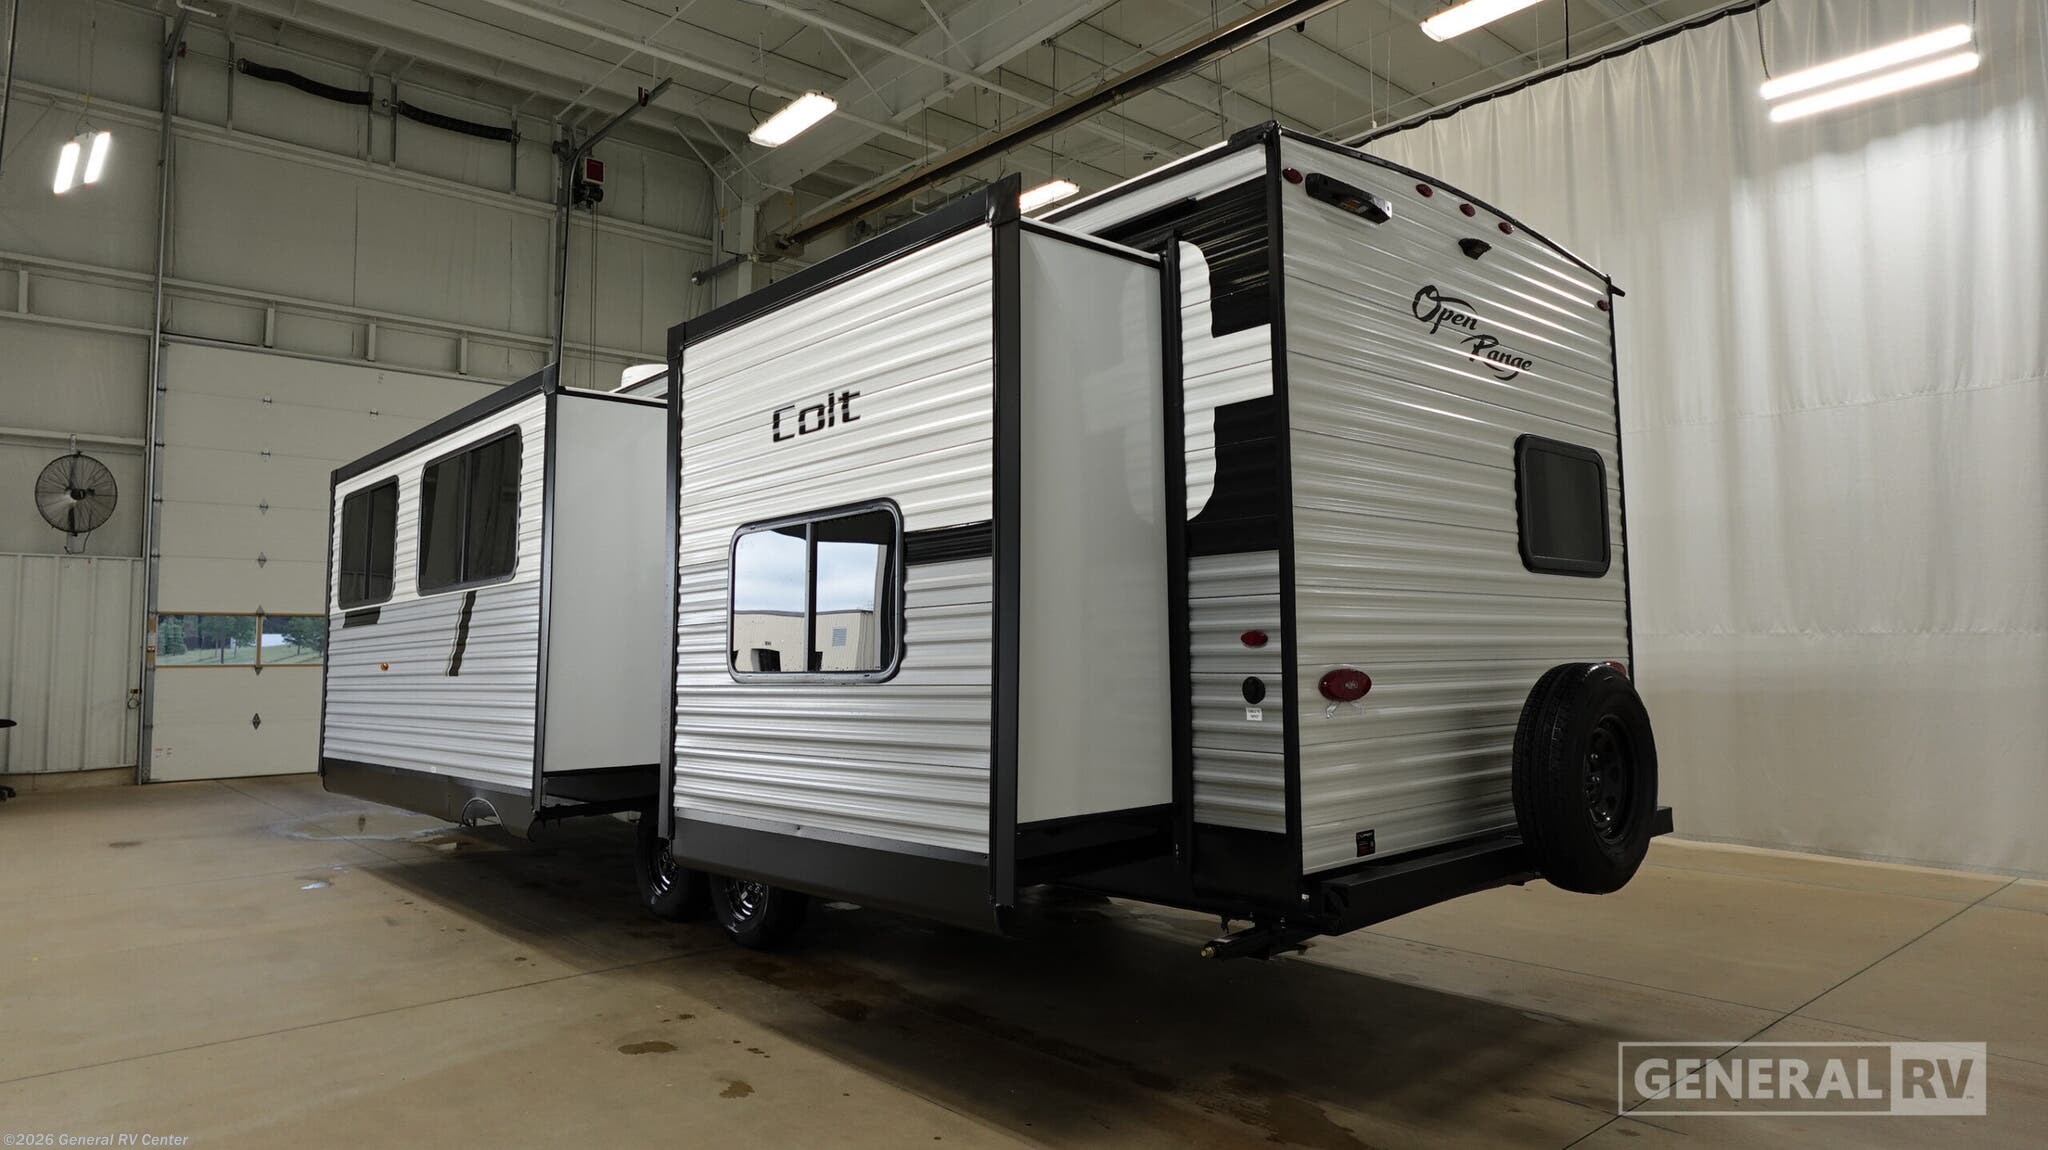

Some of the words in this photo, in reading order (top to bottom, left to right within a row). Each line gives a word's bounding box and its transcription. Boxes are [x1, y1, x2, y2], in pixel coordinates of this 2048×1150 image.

[1412, 285, 1478, 334] Open
[1460, 334, 1533, 381] Range
[772, 391, 861, 443] Colt
